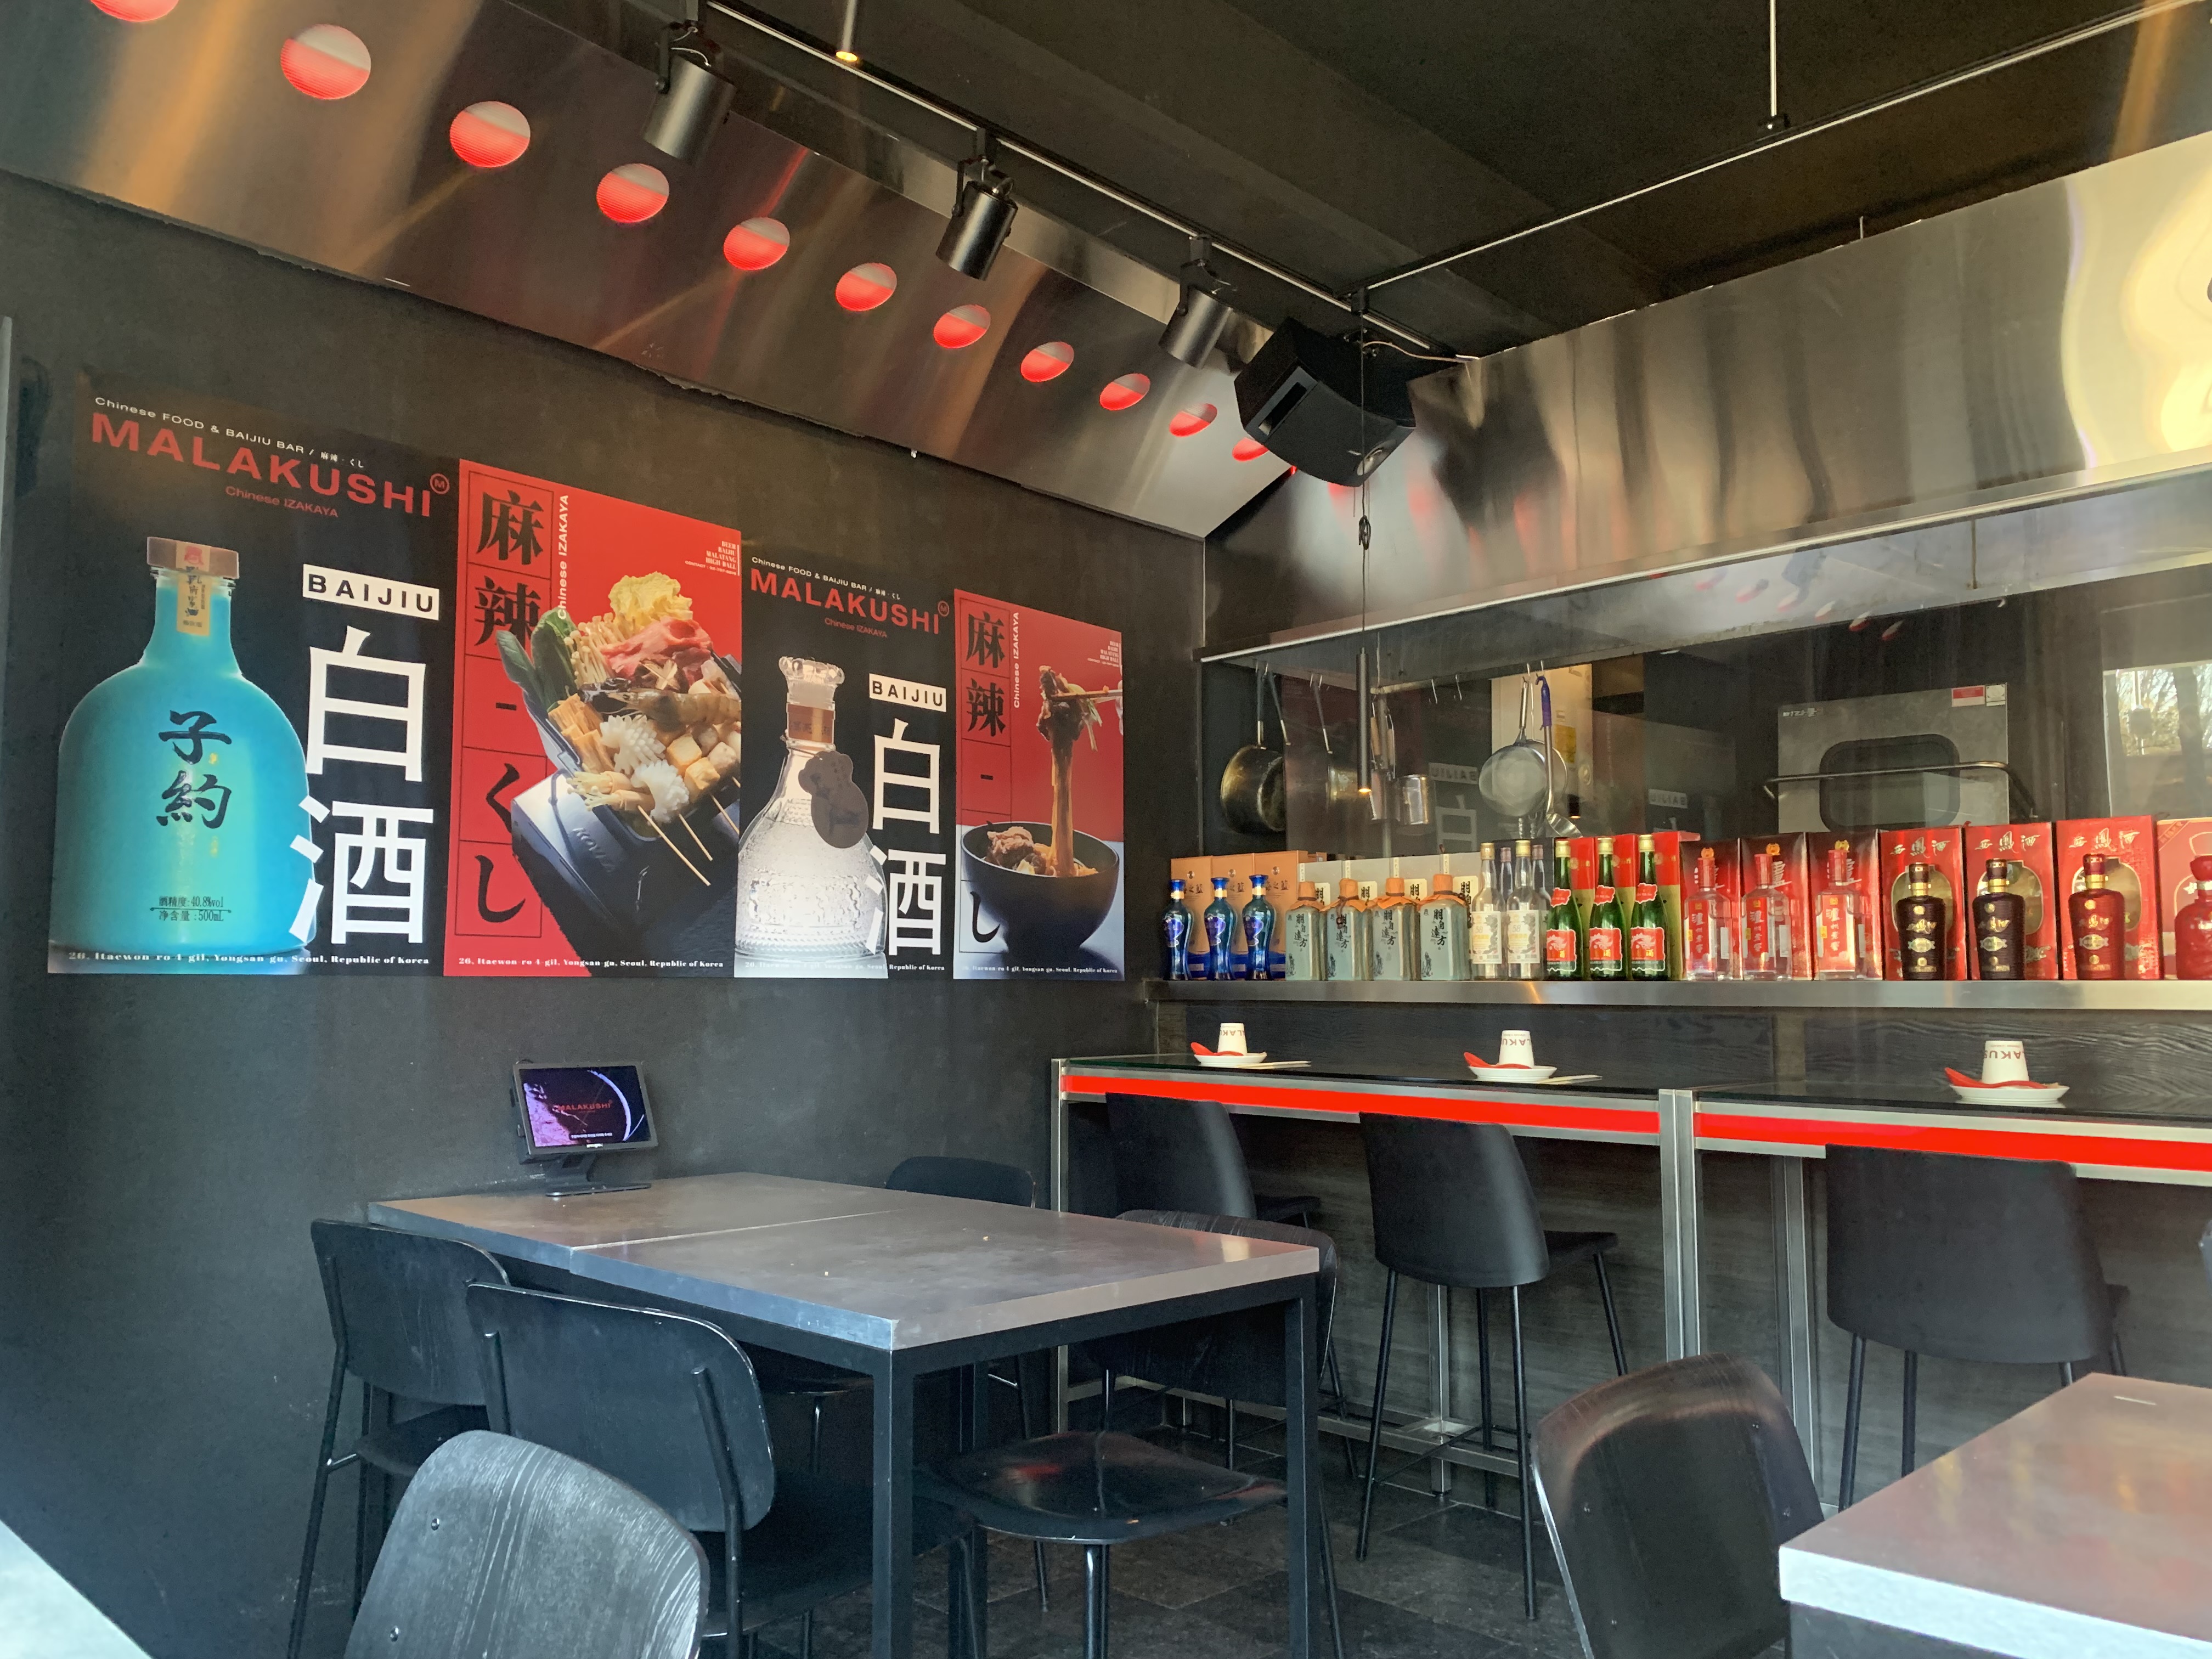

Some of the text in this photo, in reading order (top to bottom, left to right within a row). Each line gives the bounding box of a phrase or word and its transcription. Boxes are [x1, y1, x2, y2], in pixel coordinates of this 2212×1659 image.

[95, 397, 156, 417] Chinese
[163, 413, 204, 429] FOOD
[211, 425, 219, 433] &
[226, 428, 271, 445] BAIJIU
[276, 441, 304, 454] BAR
[92, 413, 430, 517] MALAKUSHI
[225, 486, 338, 517] Chinese IZAKAYA
[558, 495, 568, 619] Chinese IZAKAYA
[706, 550, 736, 563] MALATANG
[706, 557, 720, 566] HIGH
[752, 557, 785, 570] Chinese
[788, 566, 812, 577] FOOD
[823, 575, 848, 586] BAIJIU
[851, 582, 867, 591] BAR
[308, 573, 433, 613] BAIJIU
[751, 568, 938, 634] MALAKUSHI
[825, 618, 887, 638] Chinese IZAKAYA
[872, 680, 943, 707] BAIJIU
[289, 625, 434, 944] 白酒
[865, 718, 946, 955] 白酒
[291, 955, 328, 963] Seoul,
[331, 956, 381, 964] Republic
